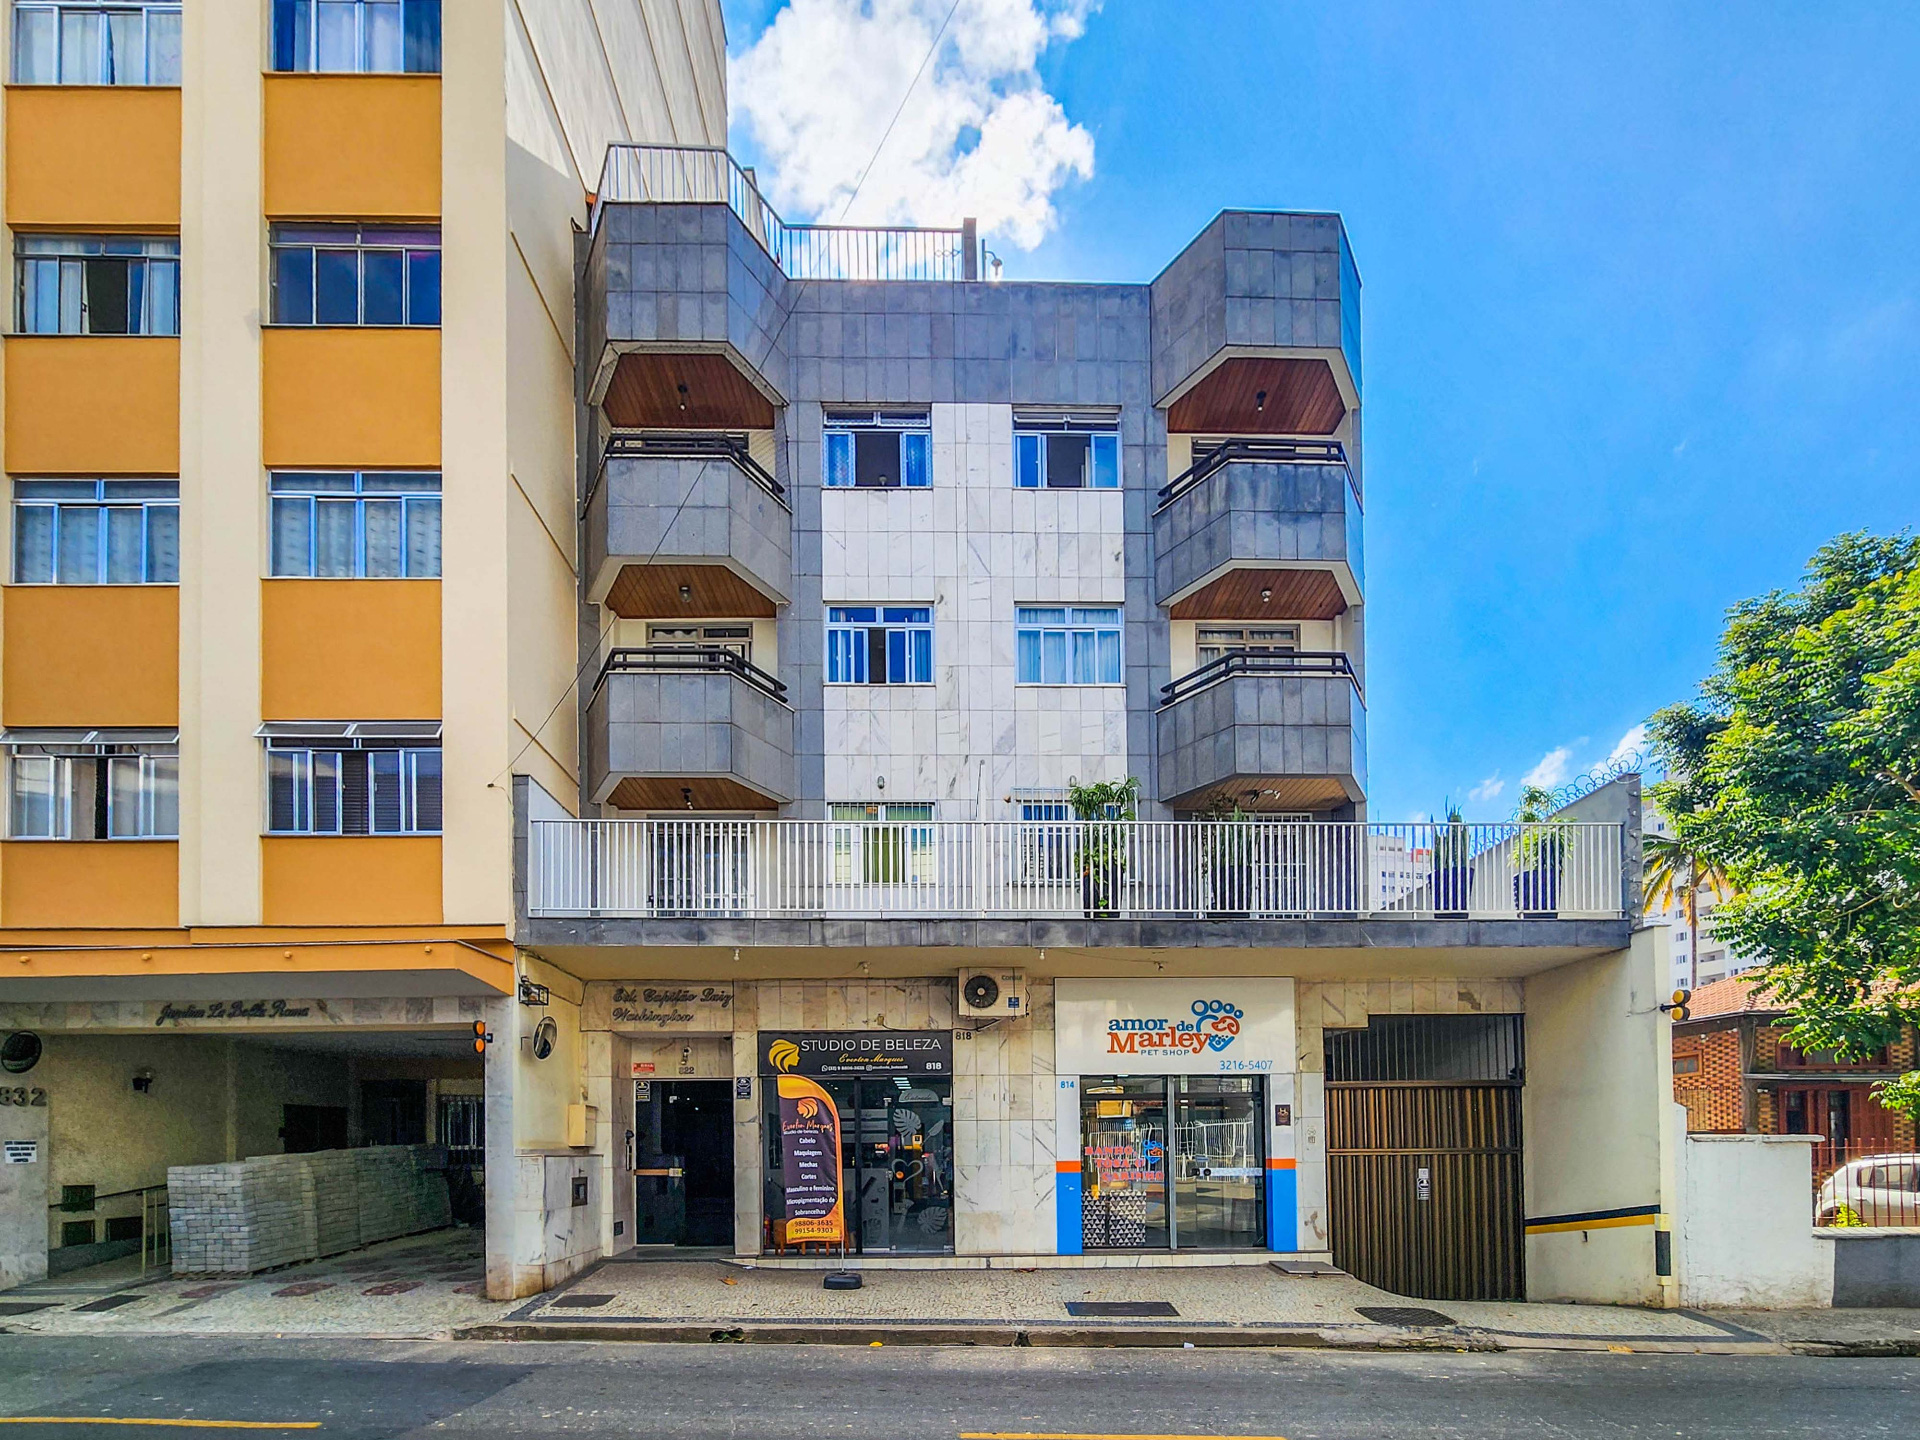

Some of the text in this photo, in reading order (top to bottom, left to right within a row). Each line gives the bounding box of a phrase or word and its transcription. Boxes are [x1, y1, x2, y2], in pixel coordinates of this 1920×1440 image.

[643, 988, 698, 1007] Capitão
[700, 988, 734, 1008] Luiz
[612, 1007, 694, 1027] Washington
[1109, 1018, 1194, 1032] amor de
[955, 1032, 973, 1041] 818
[1107, 1026, 1212, 1054] Marley
[801, 1038, 942, 1052] STUDIO DE BELEZA
[838, 1053, 905, 1064] Everton Marques
[678, 1066, 695, 1075] 822
[925, 1062, 943, 1071] 818
[1219, 1060, 1273, 1071] 3216-5407
[1060, 1080, 1075, 1089] 814
[0, 1087, 48, 1107] 832
[794, 1149, 822, 1157] Maquiagem
[786, 1186, 809, 1194] Masculino
[813, 1184, 835, 1192] feminino
[786, 1197, 828, 1205] Micropigmentação
[794, 1227, 834, 1235] 99154-9303
